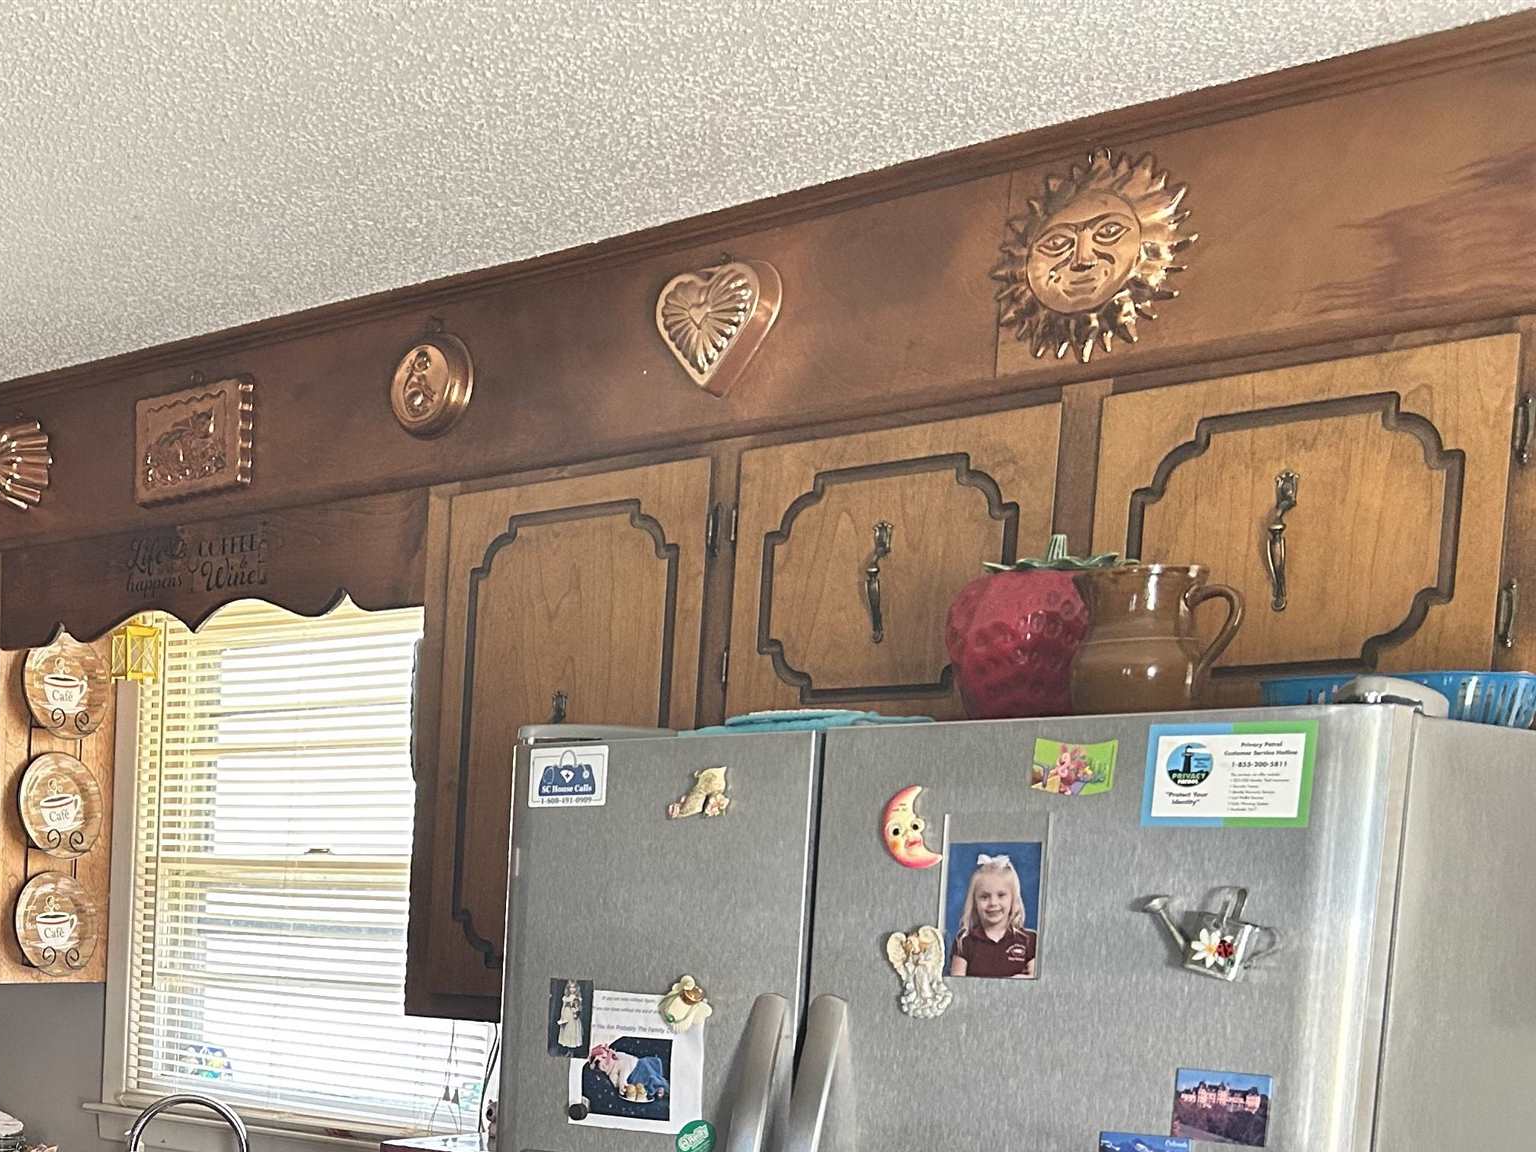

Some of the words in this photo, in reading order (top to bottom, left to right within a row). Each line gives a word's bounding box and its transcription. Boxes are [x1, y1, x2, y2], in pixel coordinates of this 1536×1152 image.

[200, 557, 257, 592] Wine
[126, 575, 183, 599] happens
[51, 690, 74, 703] Café
[1171, 772, 1207, 780] PRIVACY
[541, 785, 552, 793] SC
[552, 784, 573, 793] House
[574, 783, 592, 793] Calls
[49, 807, 71, 822] Café
[43, 924, 66, 939] Café
